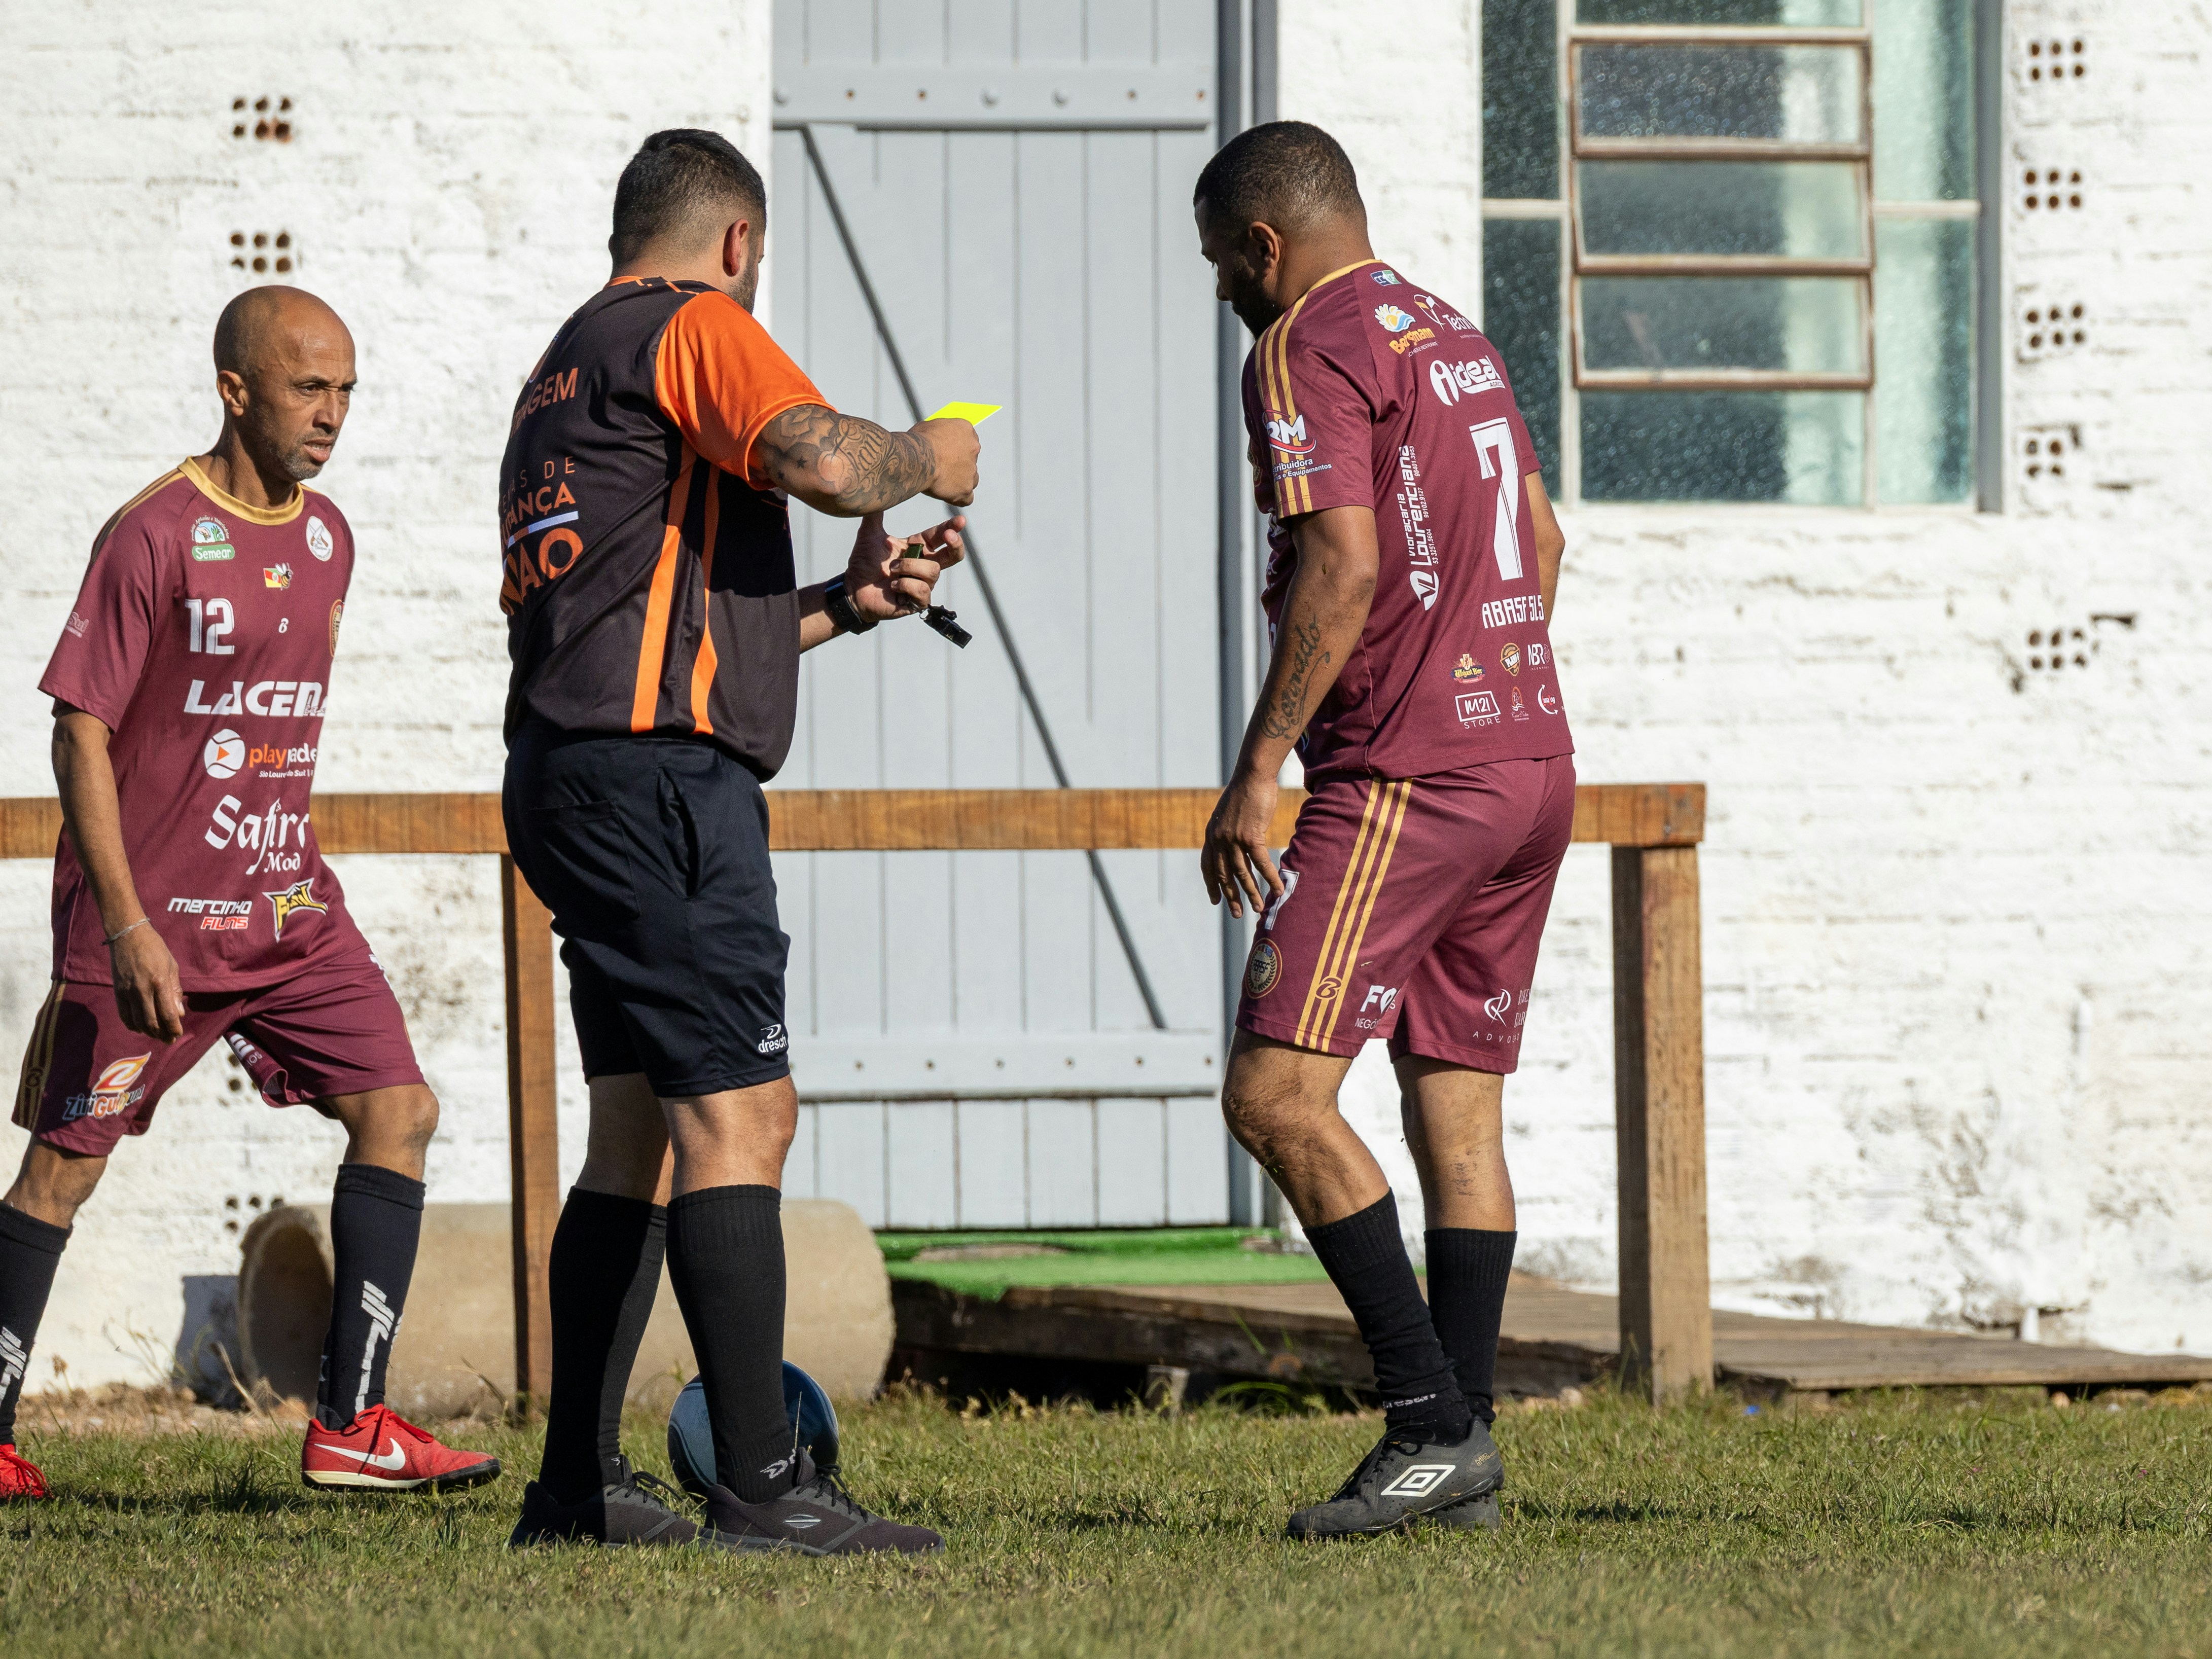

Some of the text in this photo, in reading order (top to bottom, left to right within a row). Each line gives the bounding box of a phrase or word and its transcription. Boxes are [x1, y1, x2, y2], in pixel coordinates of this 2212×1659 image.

[1388, 328, 1435, 354] Bergmann
[544, 456, 576, 479] DE
[1287, 463, 1333, 477] Equipamentos
[1409, 446, 1420, 477] 98401.3953
[1398, 445, 1433, 566] Lourenciana
[1417, 487, 1430, 518] 99102.9127
[1469, 417, 1523, 581] 7
[195, 547, 232, 560] Semear
[1426, 528, 1438, 557] 3251.5604
[1482, 594, 1545, 629] ABASF SLS
[185, 598, 235, 655] 12
[1527, 643, 1546, 666] NBR
[1464, 715, 1501, 729] STORE
[264, 851, 301, 873] Mod
[200, 916, 249, 930] FILMS
[758, 1034, 788, 1053] dresch
